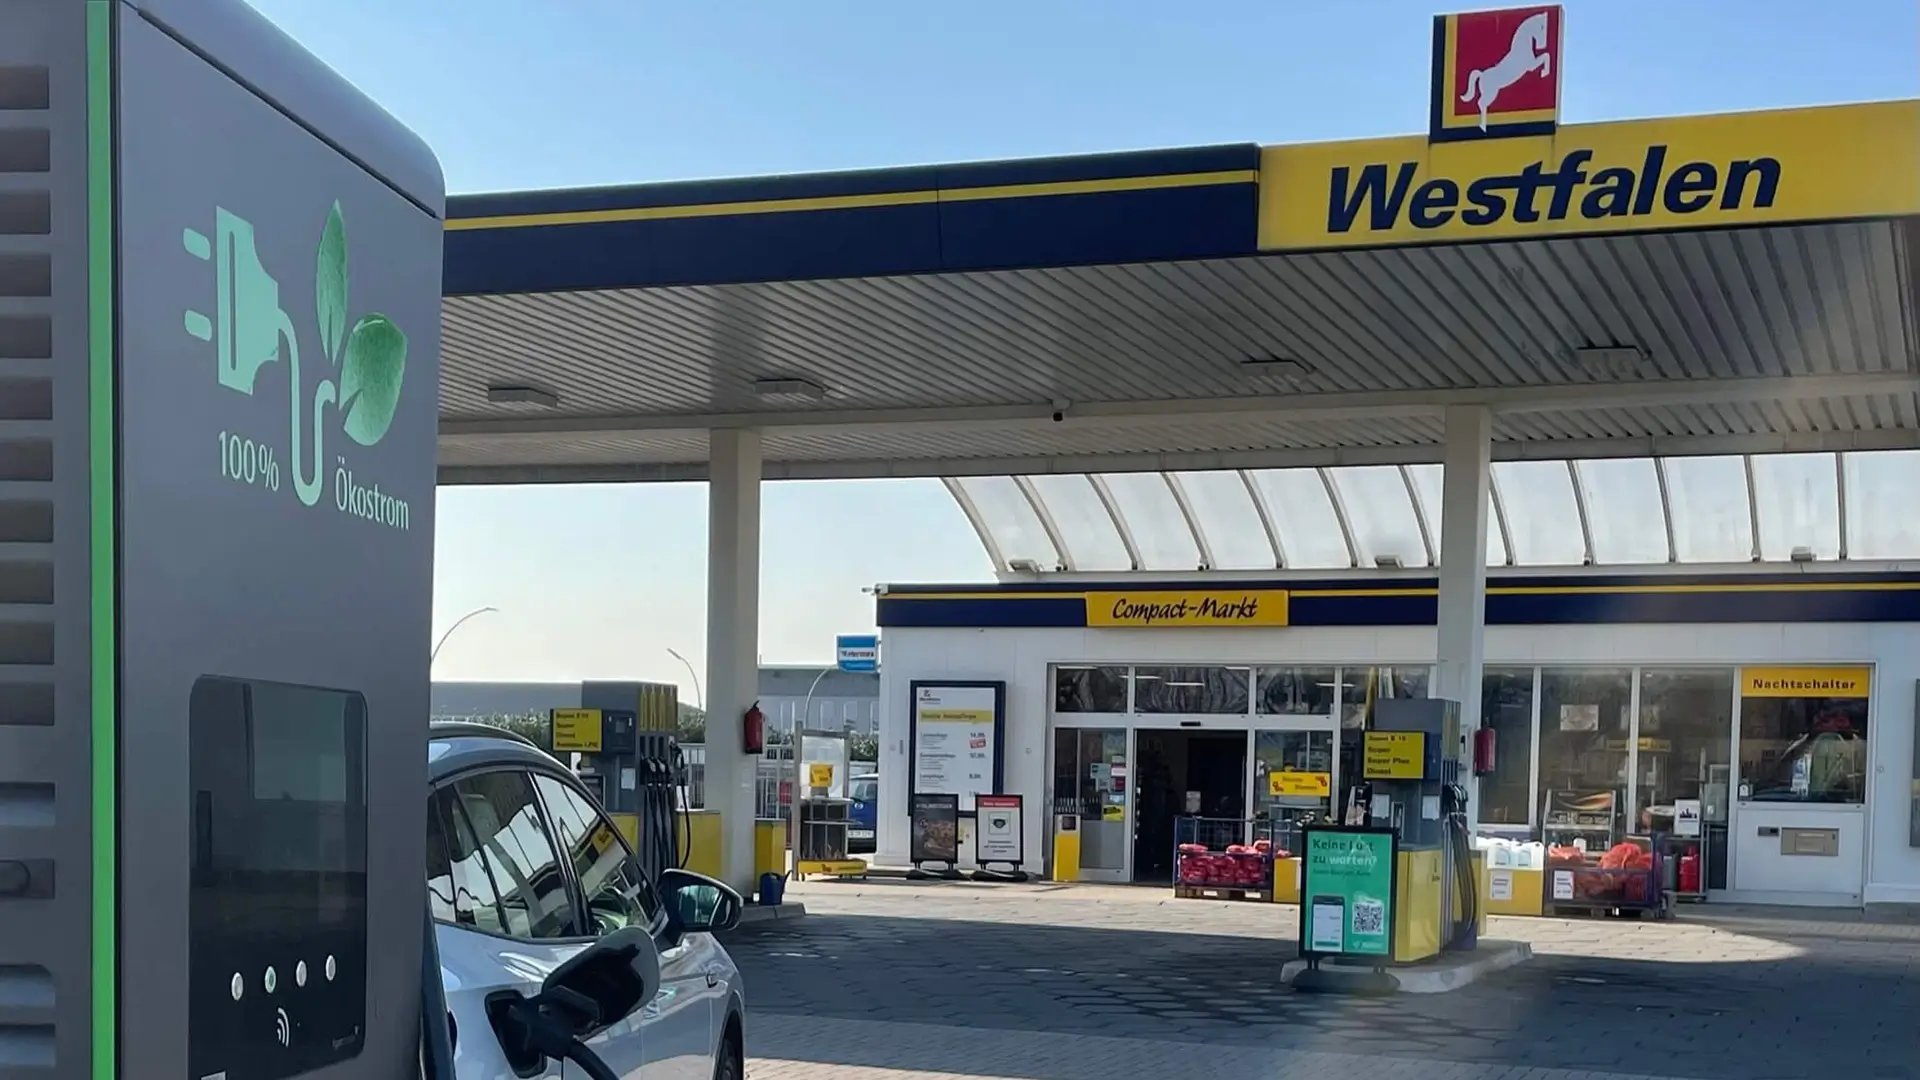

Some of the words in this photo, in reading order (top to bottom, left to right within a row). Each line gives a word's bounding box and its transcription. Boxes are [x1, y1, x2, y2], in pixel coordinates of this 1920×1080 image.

[1327, 145, 1782, 234] Westfalen
[335, 455, 410, 530] Ökostrom
[1112, 596, 1258, 624] Compact-Markt
[1753, 678, 1857, 690] Nachtschalter
[1312, 838, 1346, 850] Keine
[1312, 855, 1326, 864] zu
